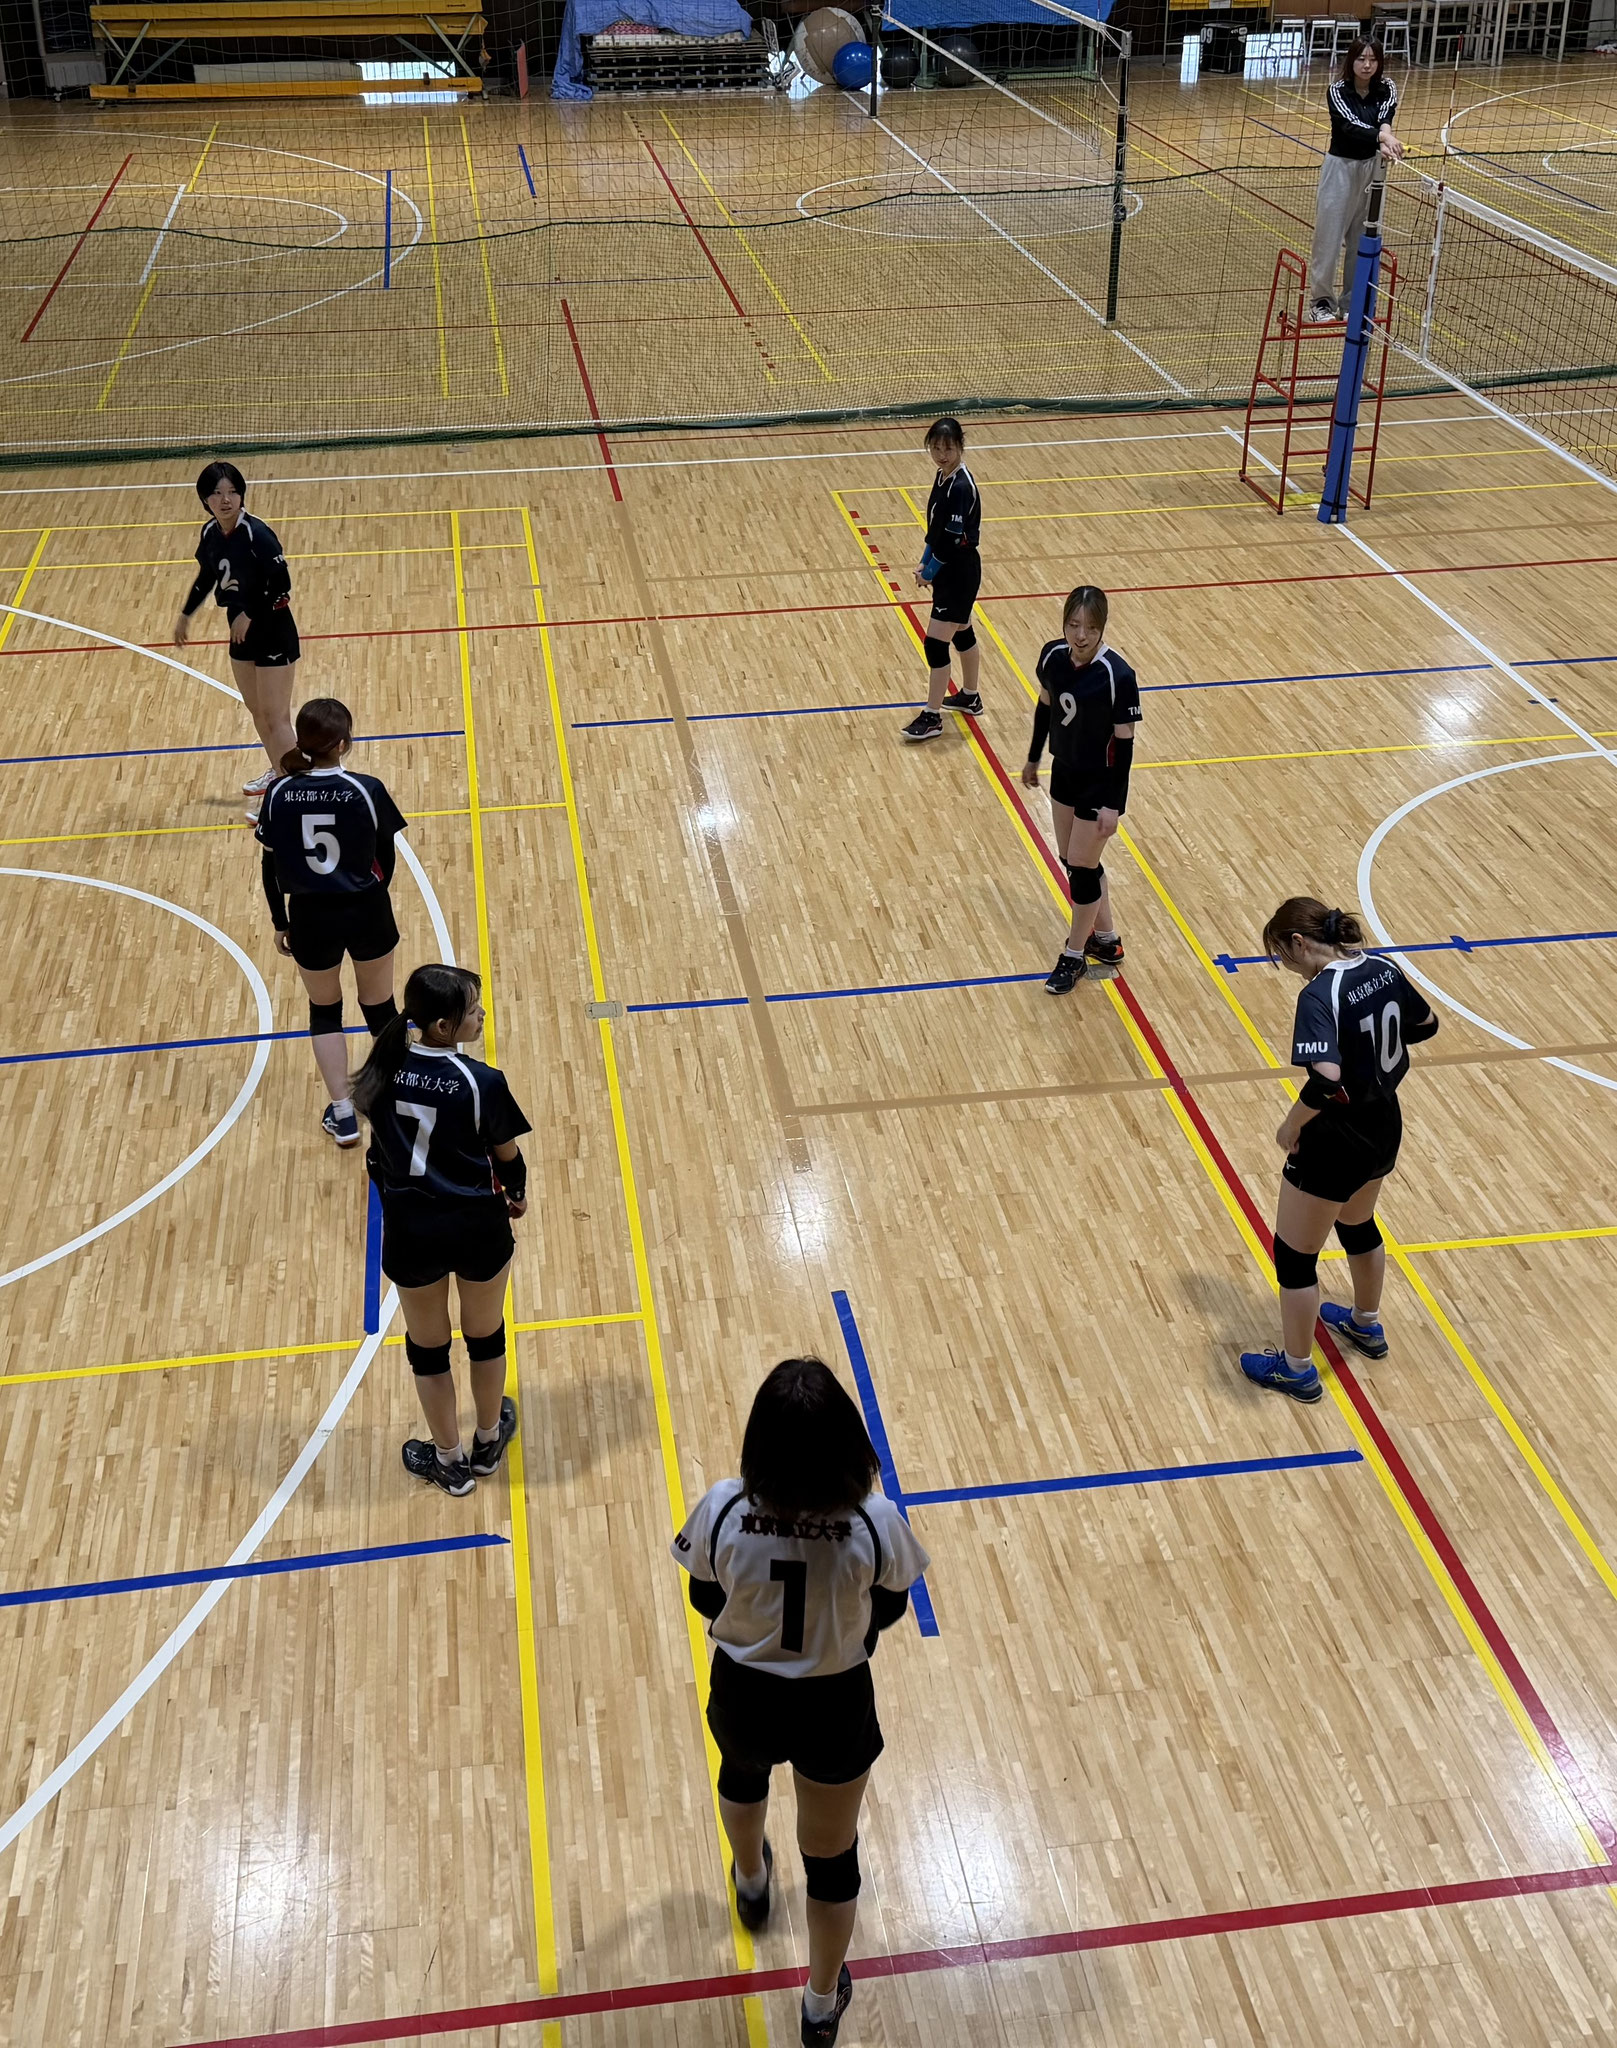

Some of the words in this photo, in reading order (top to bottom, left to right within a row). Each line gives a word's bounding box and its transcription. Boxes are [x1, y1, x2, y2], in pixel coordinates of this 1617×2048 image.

[218, 558, 239, 592] 2
[1059, 692, 1077, 727] 9
[1127, 706, 1142, 716] TM
[284, 790, 354, 803] 東京都立大学
[301, 814, 341, 875] 5
[1345, 969, 1395, 1006] 東京都立大学
[1296, 1041, 1329, 1054] TMU
[1359, 1000, 1404, 1074] 10
[393, 1069, 460, 1094] 京都立大学
[395, 1100, 437, 1177] 7
[769, 1558, 807, 1654] 1
